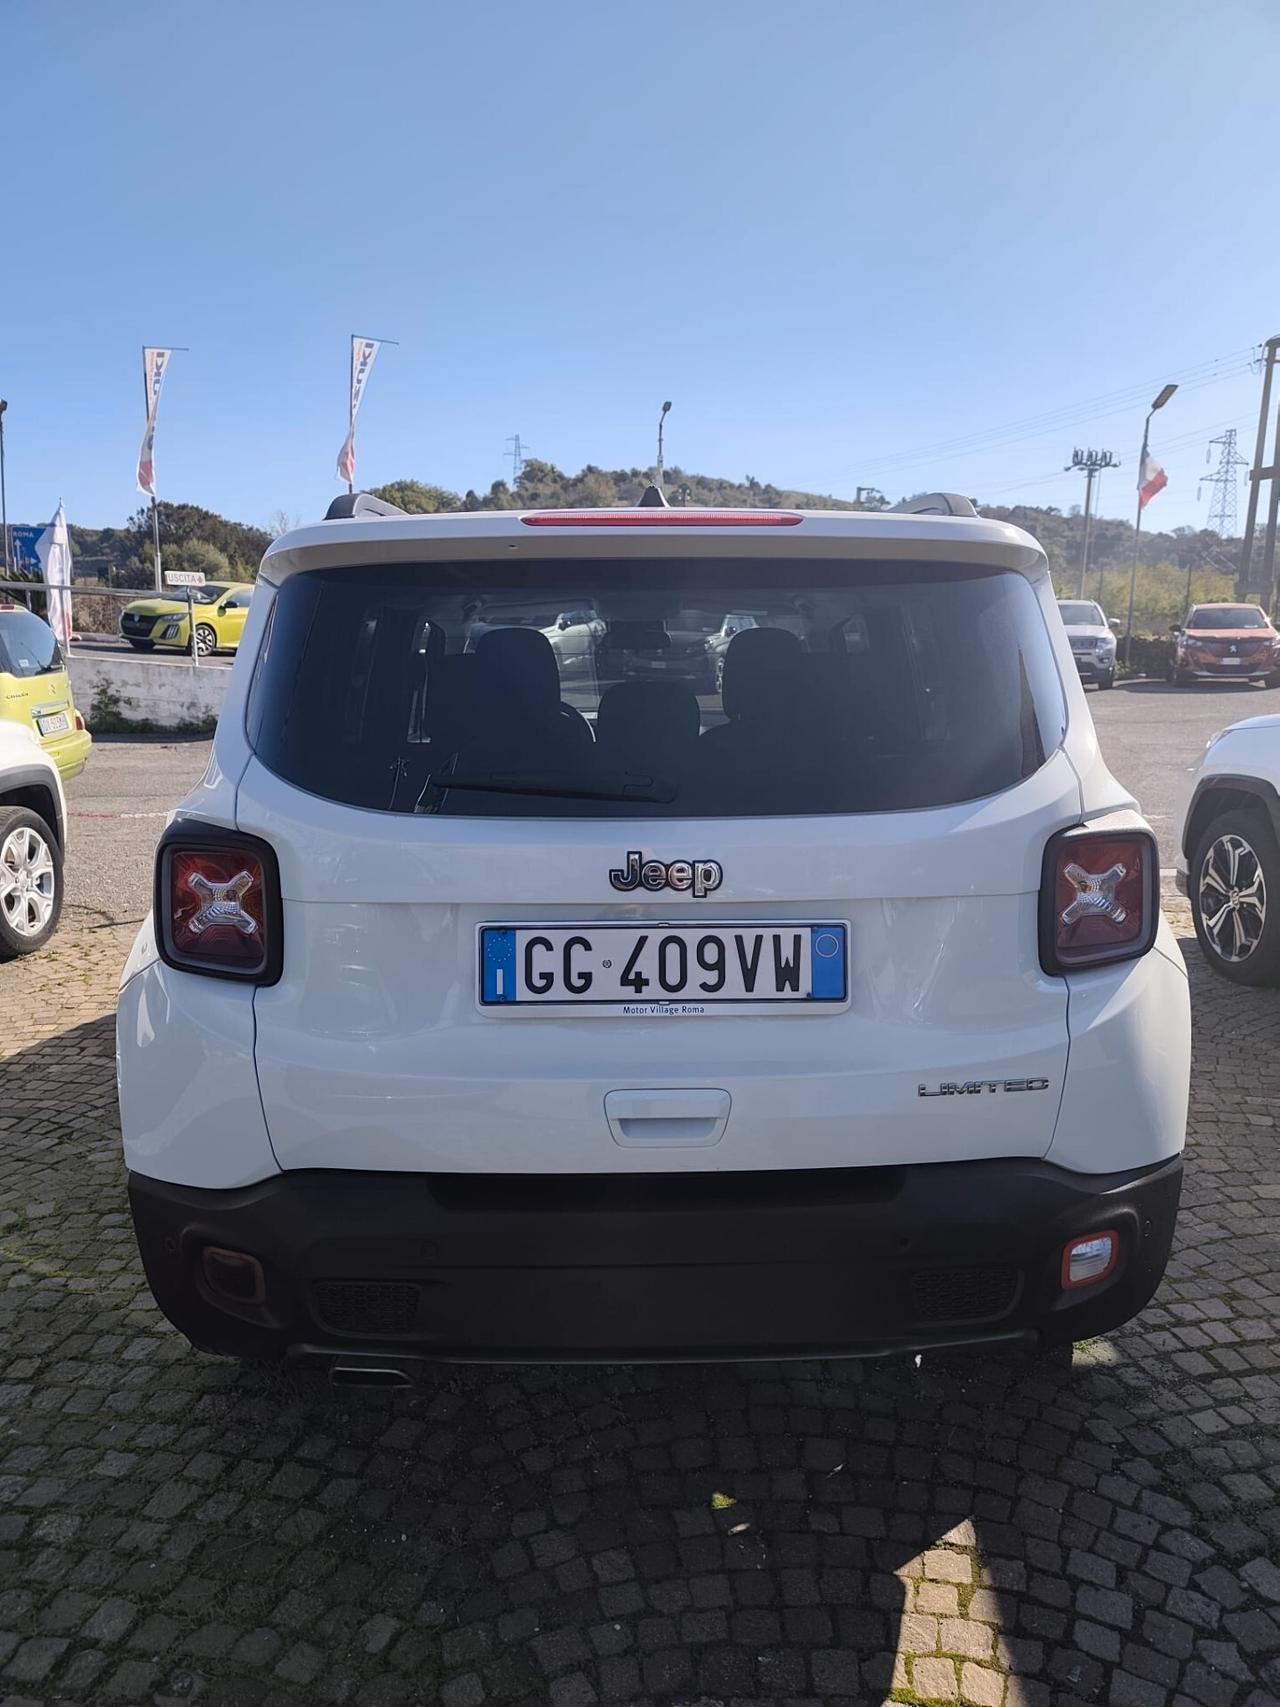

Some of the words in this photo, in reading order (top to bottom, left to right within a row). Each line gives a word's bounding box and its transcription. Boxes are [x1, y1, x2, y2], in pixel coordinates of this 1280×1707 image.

[168, 573, 197, 583] USCITA
[609, 851, 723, 898] Jeep
[524, 935, 593, 994] GG
[620, 934, 803, 994] 409VW
[623, 1006, 648, 1014] Motor
[649, 1006, 679, 1016] Village
[682, 1006, 705, 1014] Roma
[918, 1076, 1049, 1097] LIMITED
